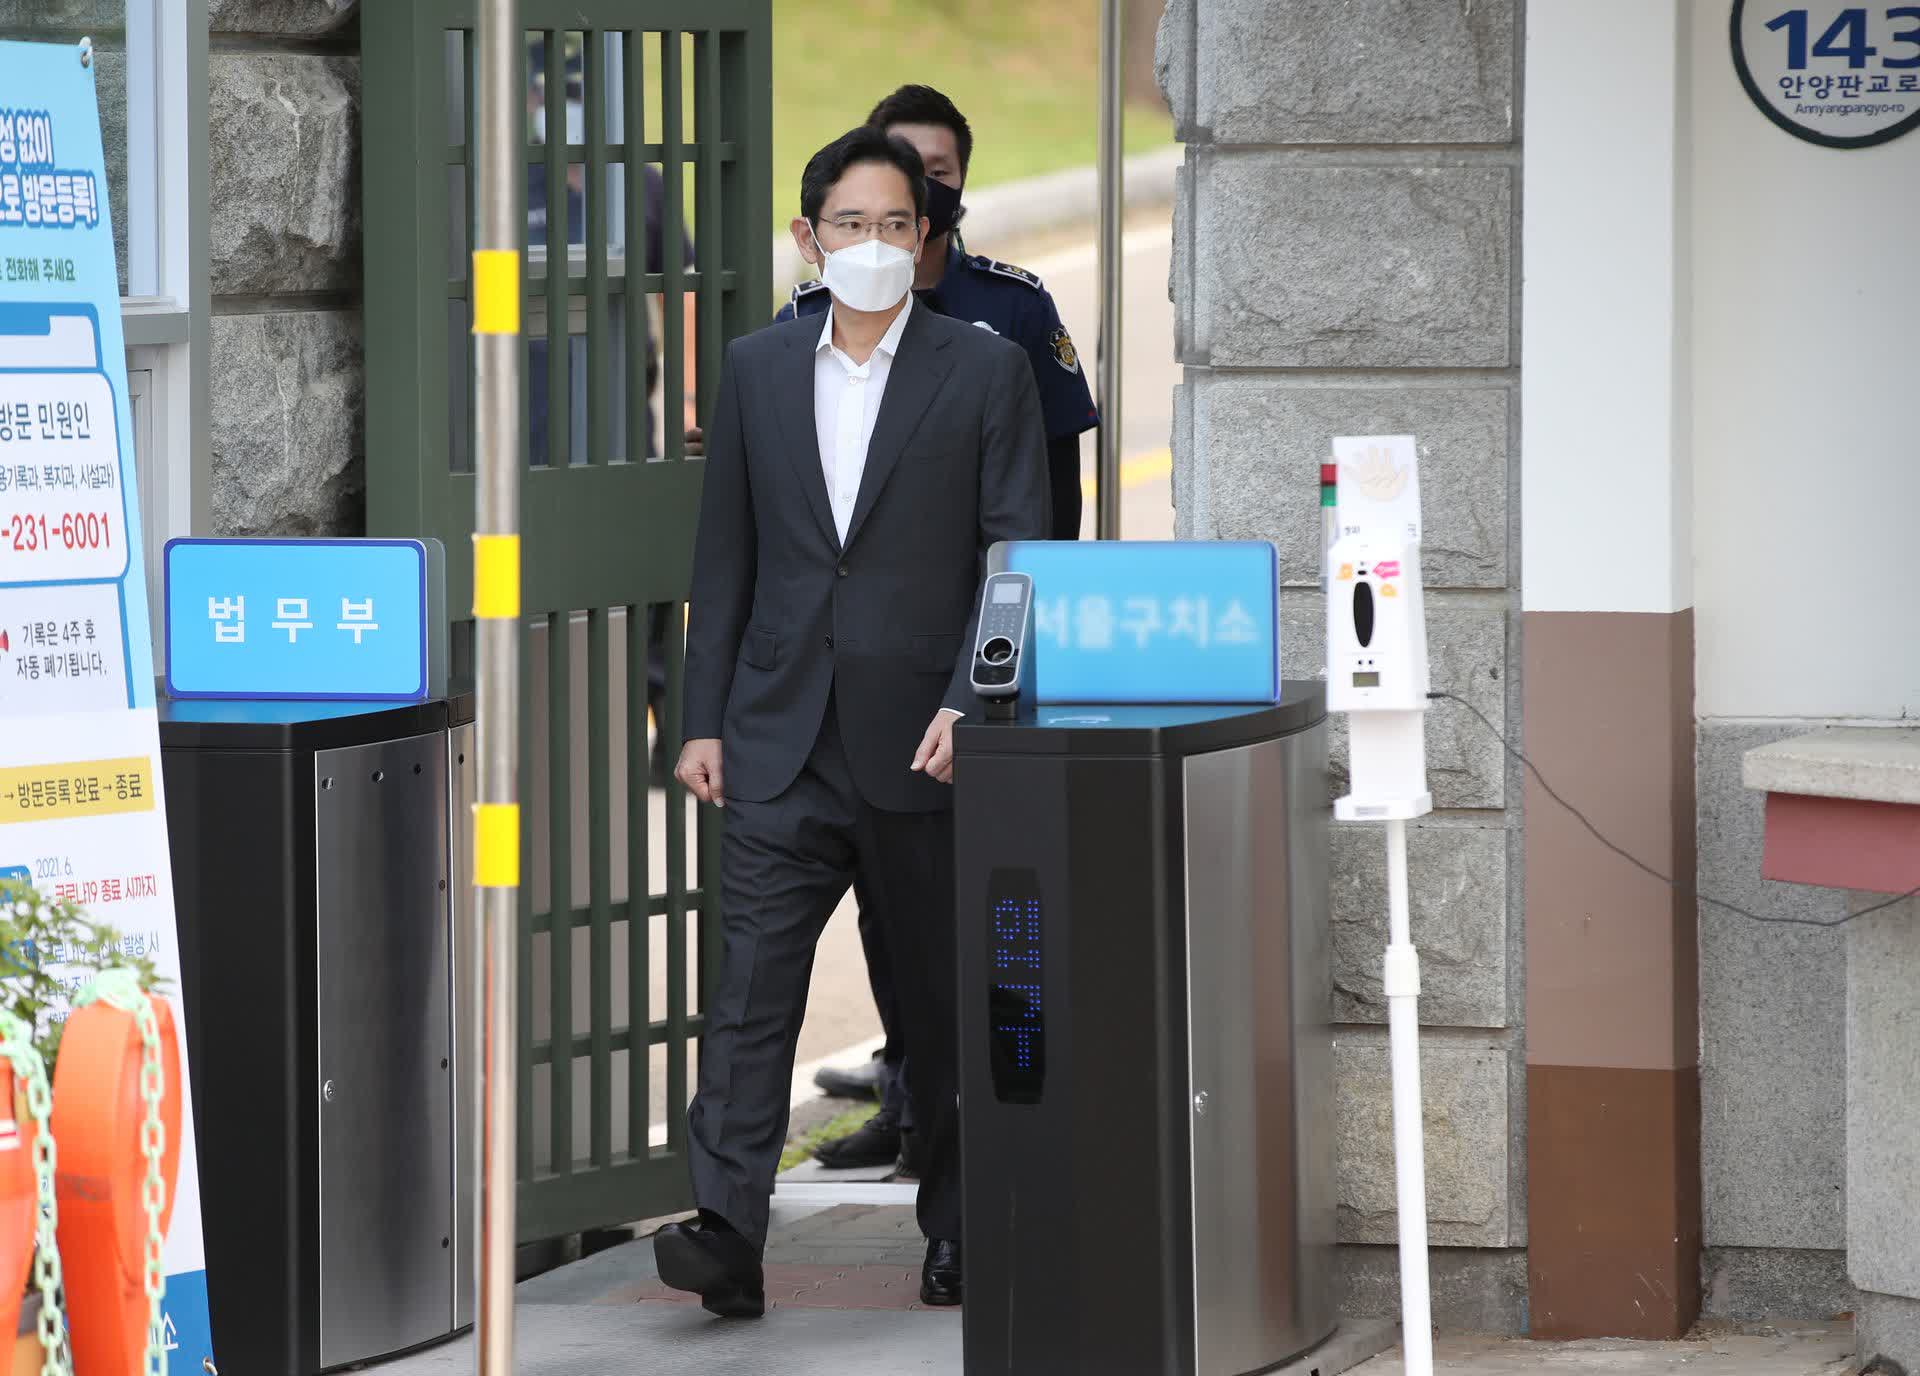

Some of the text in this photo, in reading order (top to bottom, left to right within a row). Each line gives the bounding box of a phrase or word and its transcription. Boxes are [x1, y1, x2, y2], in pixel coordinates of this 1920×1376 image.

[1765, 7, 1920, 69] 143
[1779, 75, 1920, 99] 안양판교로
[17, 115, 53, 164] 없이
[21, 174, 97, 224] 방문등록!
[6, 257, 75, 281] 전화해 주세요
[0, 401, 90, 441] 방문 민원인
[44, 463, 78, 490] 복지과,
[81, 461, 115, 489] 시설과)
[1, 510, 110, 551] -231-6001
[23, 617, 96, 648] 기록은 4주 후
[16, 646, 107, 680] 자동 폐기됩니다.
[17, 774, 143, 808] 방문등록 완료 종료
[101, 879, 122, 902] 종료
[125, 874, 157, 898] 시까지
[123, 935, 145, 957] 발생
[149, 930, 160, 953] 시
